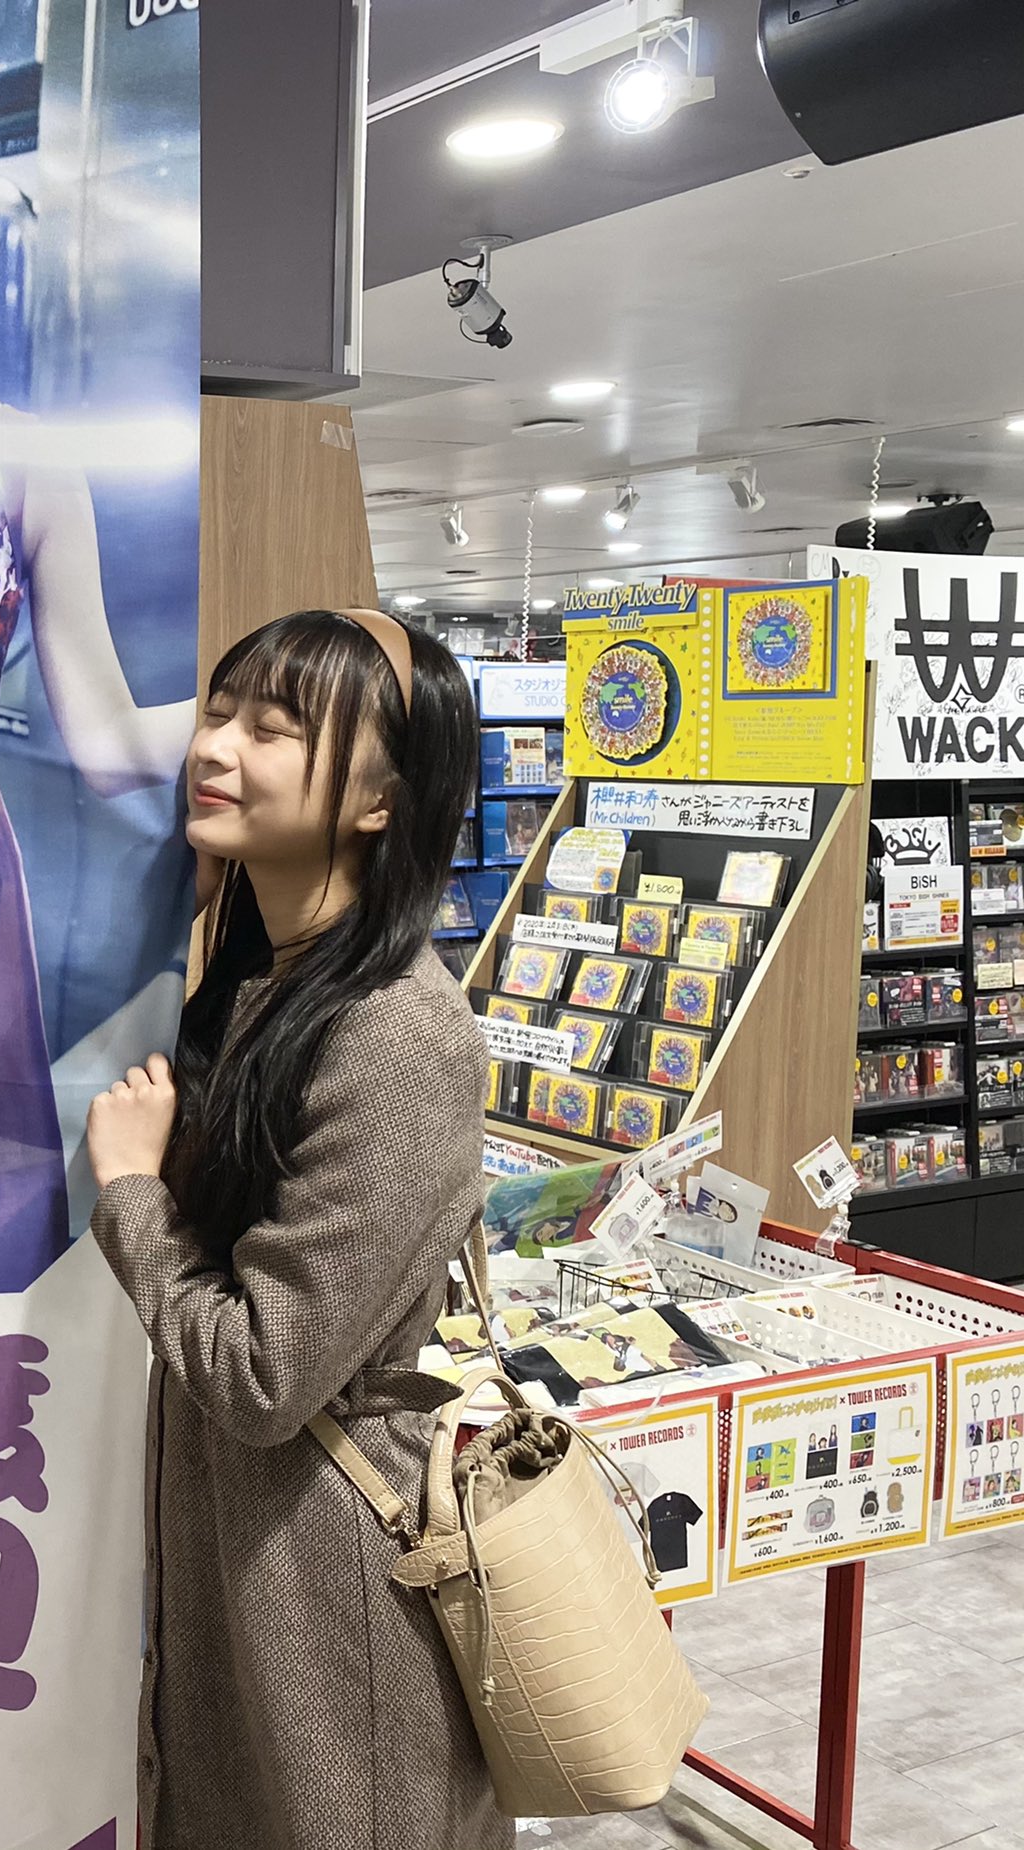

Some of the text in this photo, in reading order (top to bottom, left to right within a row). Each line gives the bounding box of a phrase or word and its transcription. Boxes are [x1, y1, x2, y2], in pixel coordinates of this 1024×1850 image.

[607, 610, 645, 631] smile
[523, 695, 557, 708] STUDIO
[896, 715, 1024, 764] WACK
[910, 875, 938, 889] BiSH
[847, 1391, 874, 1406] TOWER
[874, 1383, 908, 1402] RECORDS
[618, 1433, 647, 1451] TOWER
[647, 1425, 685, 1445] RECORDS
